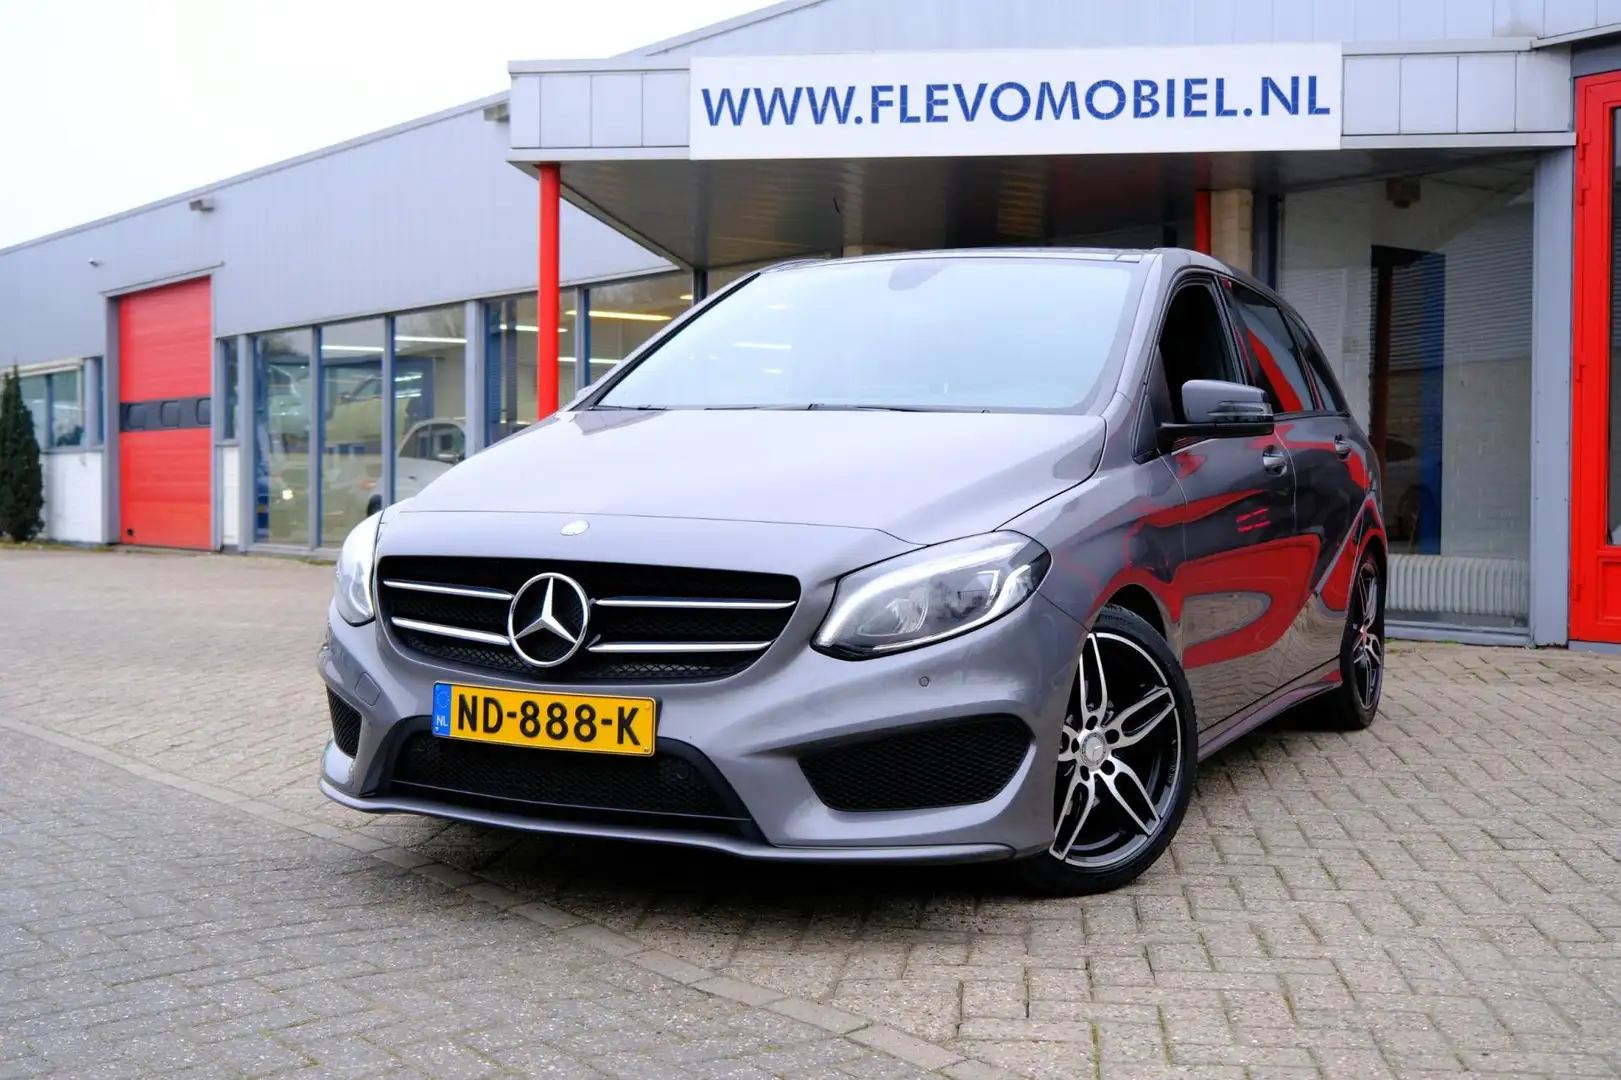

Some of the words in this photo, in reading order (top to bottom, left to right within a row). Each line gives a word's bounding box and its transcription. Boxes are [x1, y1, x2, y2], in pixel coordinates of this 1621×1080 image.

[701, 75, 1331, 126] WWW.FLEVOMOBIEL.NL
[436, 714, 449, 728] NL
[457, 694, 641, 746] ND-888-K
